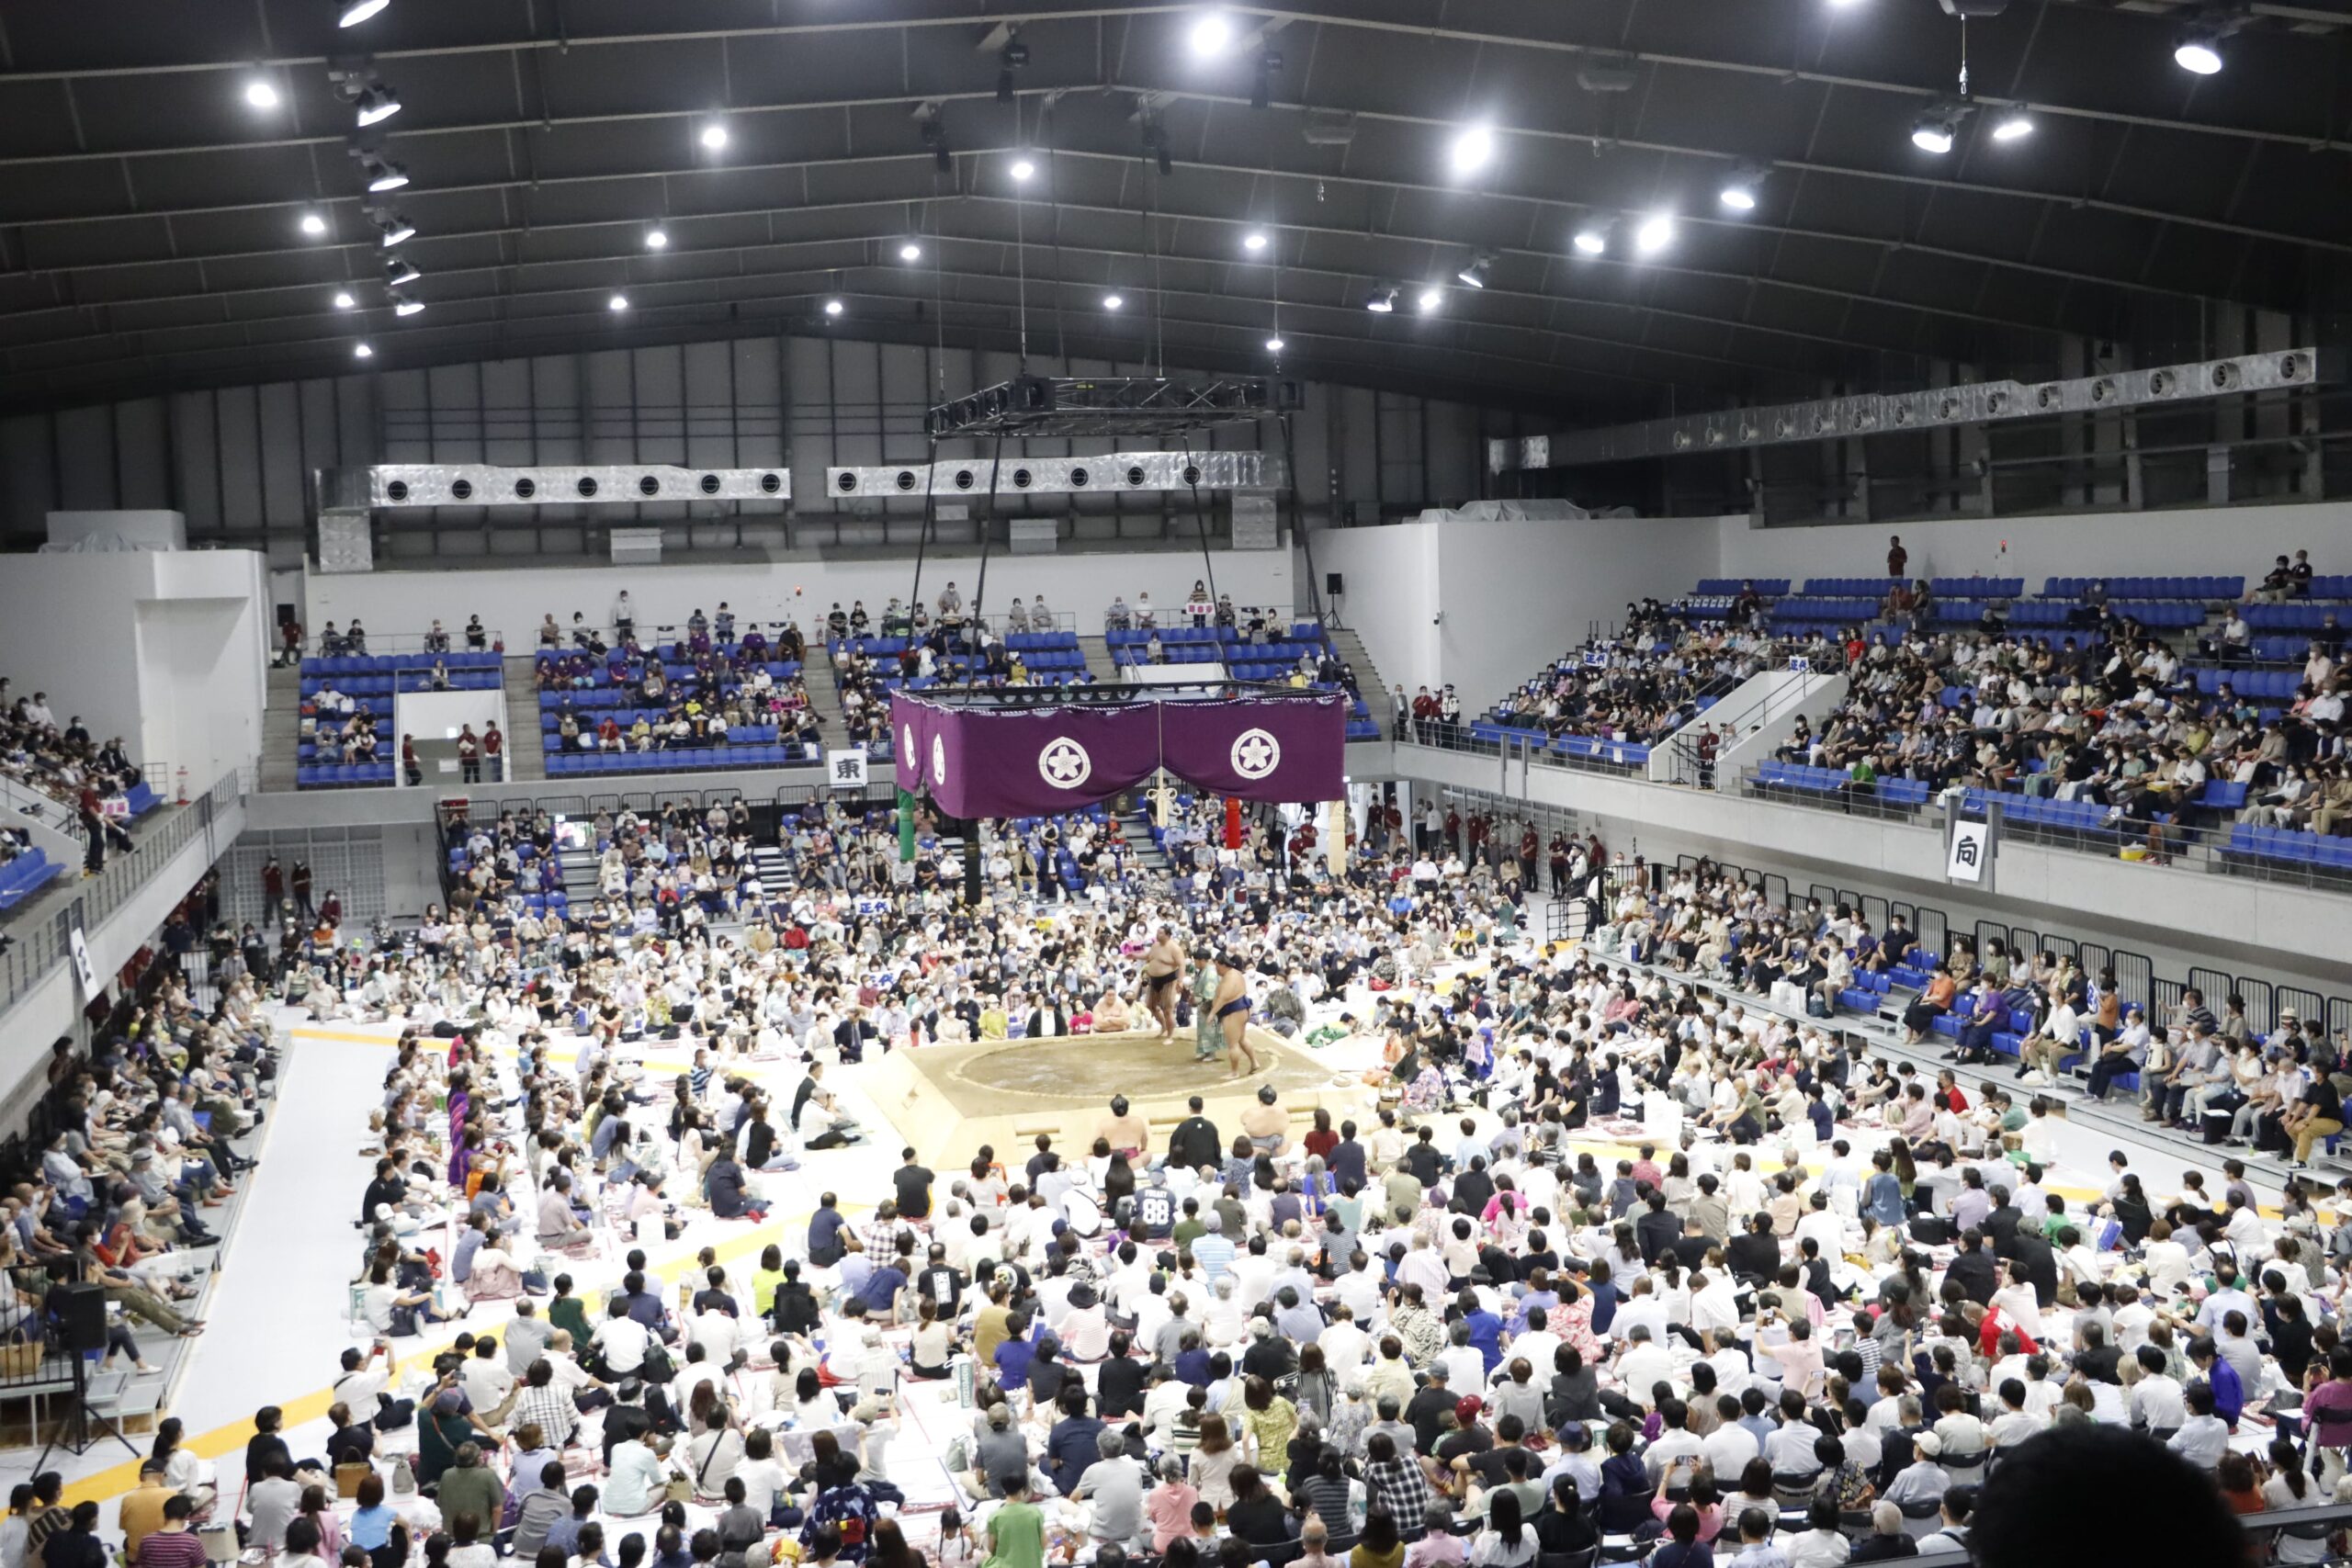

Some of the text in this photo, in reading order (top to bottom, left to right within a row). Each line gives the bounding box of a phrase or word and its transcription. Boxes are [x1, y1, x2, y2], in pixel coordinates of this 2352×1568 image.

[836, 758, 860, 779] 東
[1956, 835, 1977, 867] 向
[859, 901, 888, 913] 正代
[1143, 1198, 1170, 1225] 88
